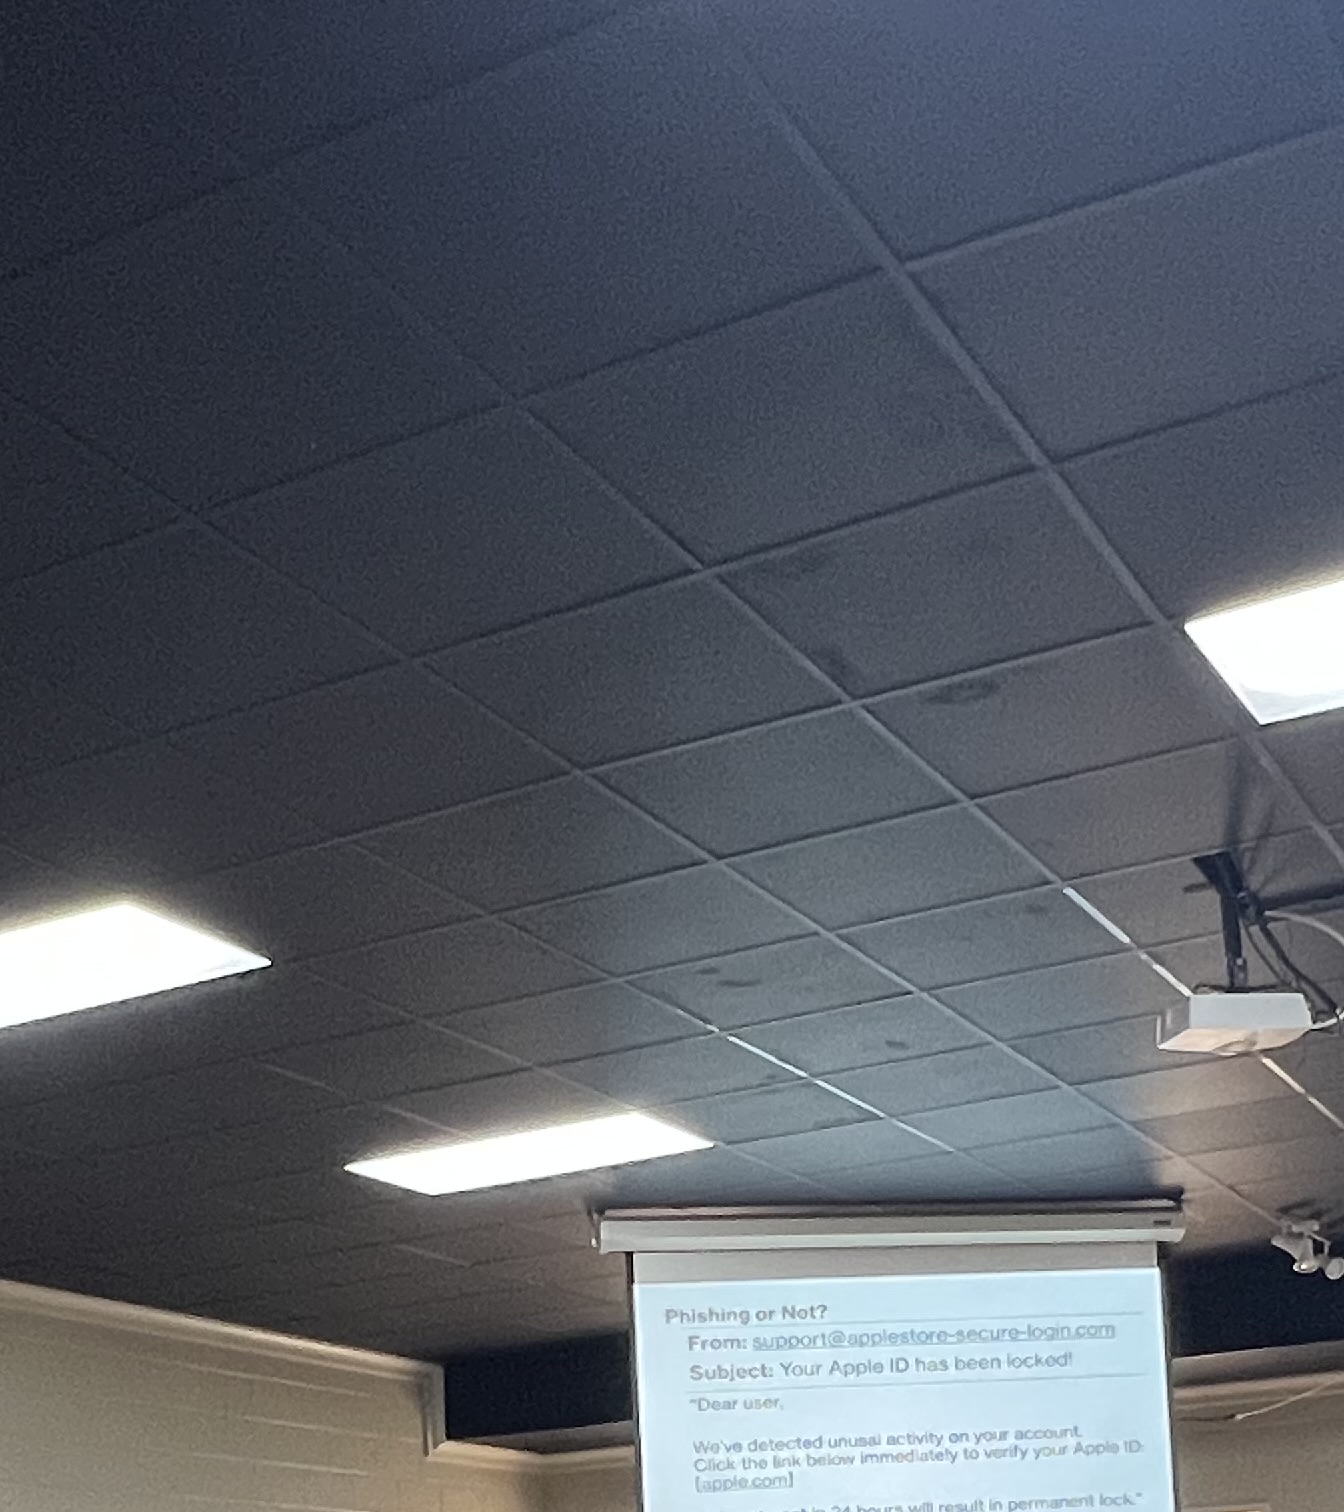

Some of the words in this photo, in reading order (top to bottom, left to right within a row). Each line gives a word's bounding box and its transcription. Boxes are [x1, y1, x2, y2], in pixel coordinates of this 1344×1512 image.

[664, 1307, 750, 1325] Phishing
[755, 1308, 775, 1321] or
[782, 1304, 828, 1320] Not?
[688, 1335, 747, 1350] From:
[752, 1324, 1116, 1351] support@applestore-secure-login.com
[689, 1363, 773, 1381] Subject:
[779, 1361, 822, 1377] Your
[828, 1358, 884, 1377] Apple
[889, 1357, 909, 1373] ID
[914, 1357, 949, 1372] has
[954, 1355, 1001, 1370] been
[1006, 1352, 1072, 1368] locked!
[743, 1397, 785, 1411] user,
[692, 1440, 743, 1454] We've
[747, 1435, 823, 1451] detected
[887, 1431, 944, 1447] activity
[948, 1432, 969, 1444] on
[974, 1430, 1009, 1445] your
[694, 1457, 736, 1473] Click
[742, 1455, 768, 1470] the
[772, 1453, 800, 1469] link
[806, 1451, 855, 1467] below
[860, 1447, 957, 1465] immediately
[963, 1447, 979, 1460] to
[984, 1444, 1028, 1460] verify
[1033, 1445, 1068, 1460] your
[1073, 1441, 1119, 1457] Apple
[694, 1471, 793, 1493] [apple.com]
[989, 1498, 1003, 1511] in
[1008, 1494, 1094, 1512] permanent
